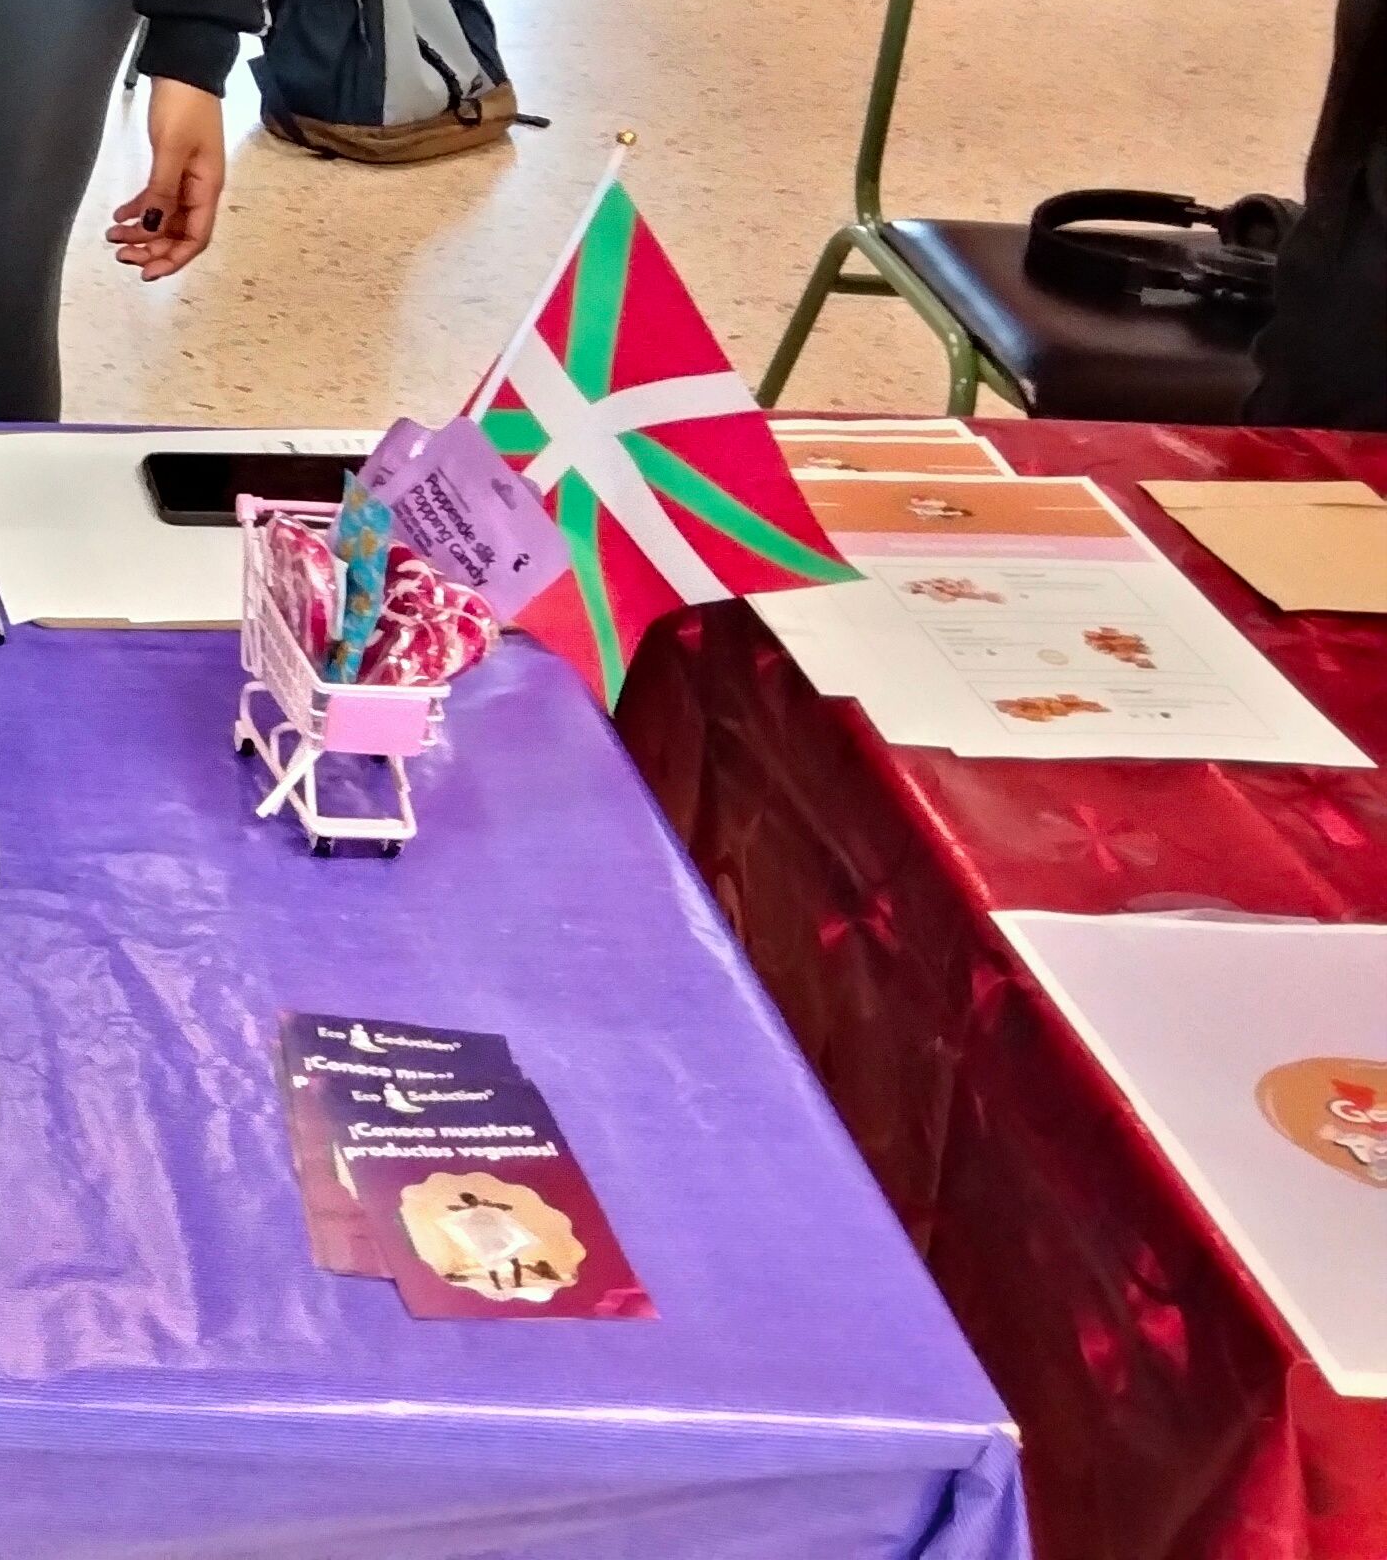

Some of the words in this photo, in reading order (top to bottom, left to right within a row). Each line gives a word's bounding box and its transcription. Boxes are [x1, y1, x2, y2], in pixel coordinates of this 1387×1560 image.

[409, 484, 455, 545] Popping
[448, 543, 489, 588] candy
[317, 1026, 347, 1040] Eco
[303, 1055, 393, 1078] ¡Conoce
[351, 1090, 382, 1102] Eco
[349, 1122, 437, 1140] ¡Conoce
[439, 1123, 536, 1139] nuestros
[341, 1141, 454, 1162] productos
[456, 1140, 560, 1161] veganos!
